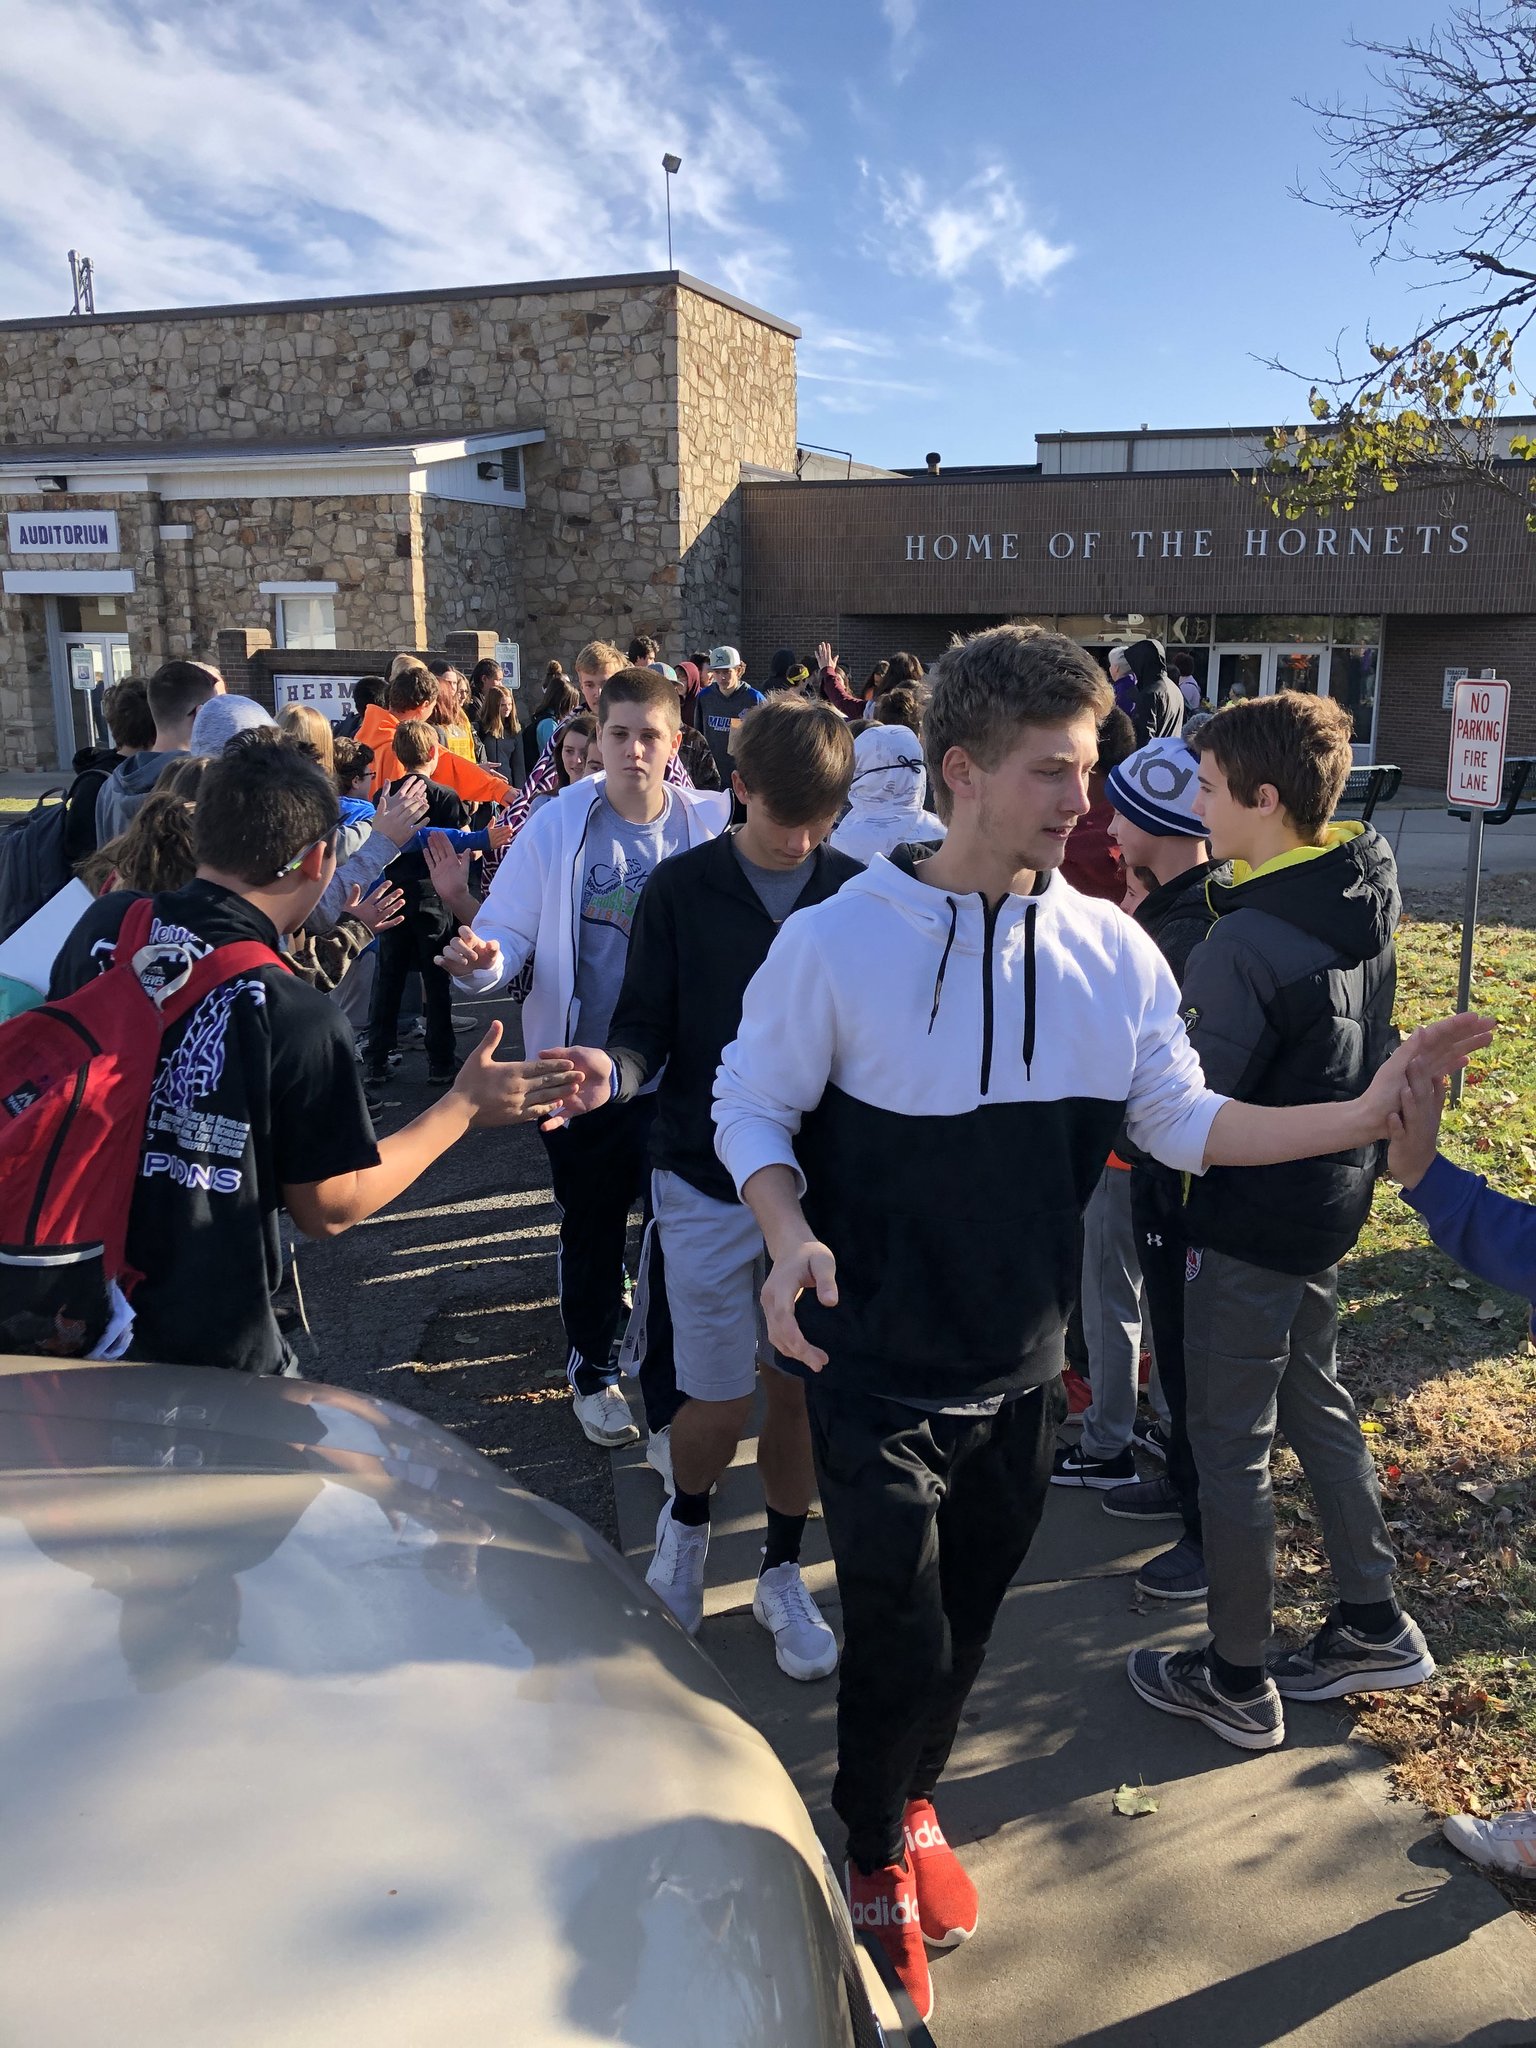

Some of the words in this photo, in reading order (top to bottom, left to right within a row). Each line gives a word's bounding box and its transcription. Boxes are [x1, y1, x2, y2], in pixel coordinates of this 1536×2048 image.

[20, 525, 108, 545] AUDITORIUM
[905, 534, 1018, 561] HOME
[1049, 532, 1100, 559] OF
[1131, 530, 1213, 557] THE
[1244, 525, 1469, 556] HORNETS
[287, 683, 354, 702] HERM
[1471, 693, 1490, 713] NO
[708, 715, 730, 728] MUL
[1457, 719, 1500, 742] PARKING
[1464, 750, 1488, 768] FIRE
[1461, 773, 1488, 791] LANE
[143, 1152, 242, 1194] PIONS
